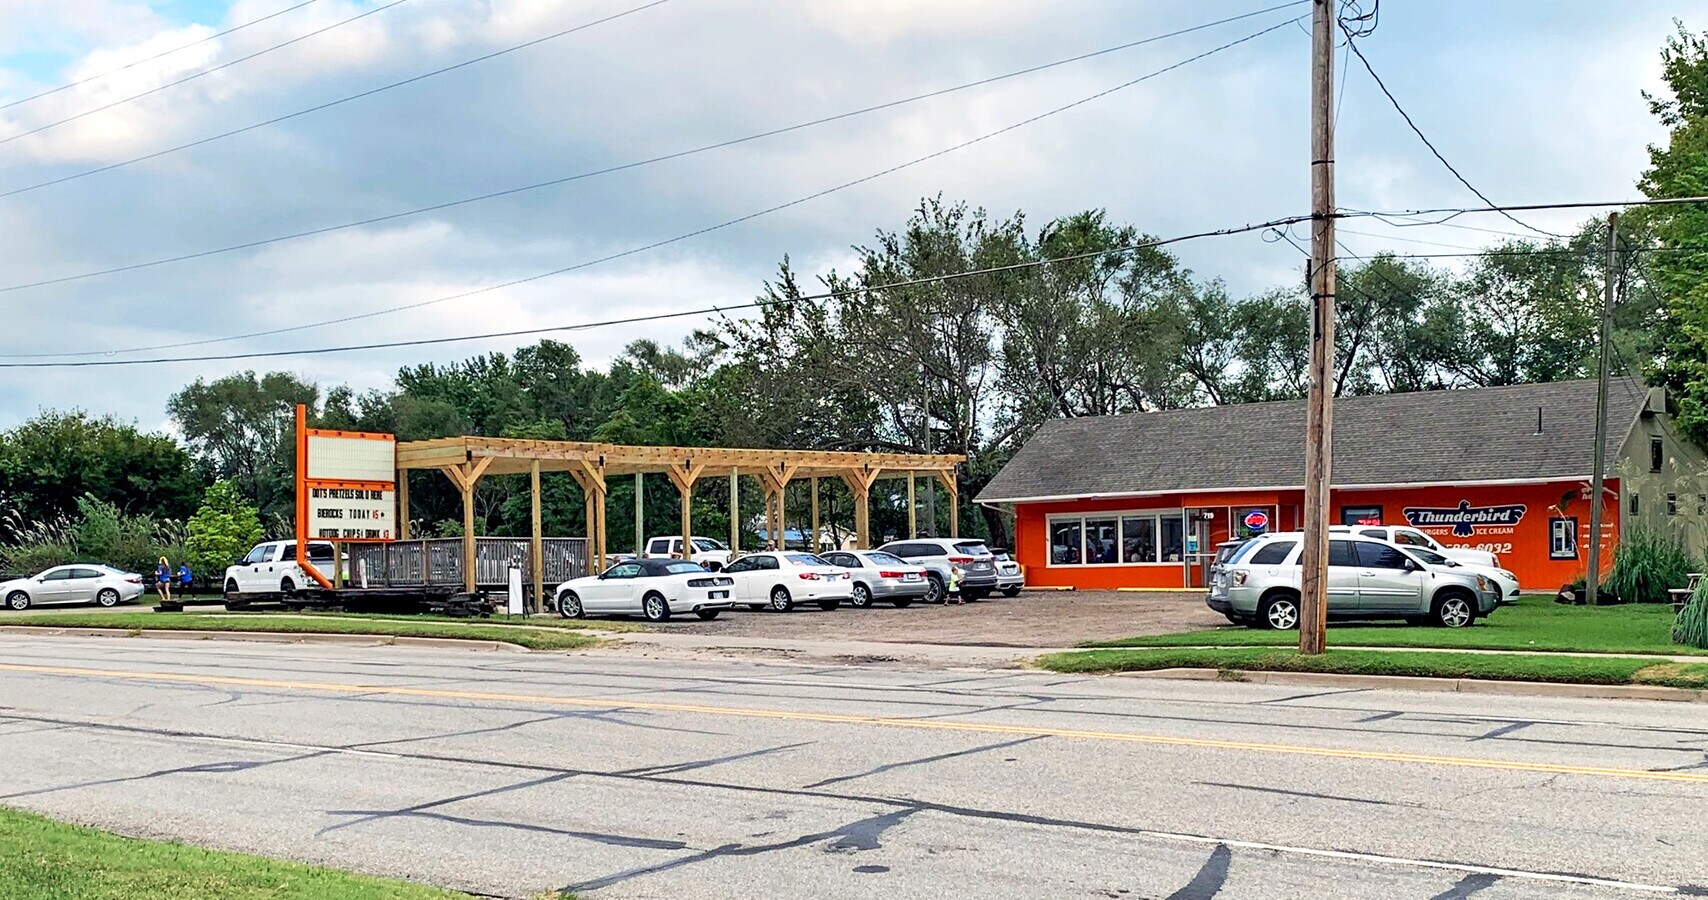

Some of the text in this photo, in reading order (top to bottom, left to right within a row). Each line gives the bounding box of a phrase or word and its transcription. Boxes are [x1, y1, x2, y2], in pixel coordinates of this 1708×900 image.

[329, 489, 354, 499] PRETZELS
[371, 490, 383, 500] HERE
[317, 508, 343, 518] BIEROCKS
[349, 509, 370, 519] TODAY
[1417, 508, 1512, 523] Thunderbird
[343, 529, 360, 538] CHIPS
[1489, 527, 1514, 535] CREAM
